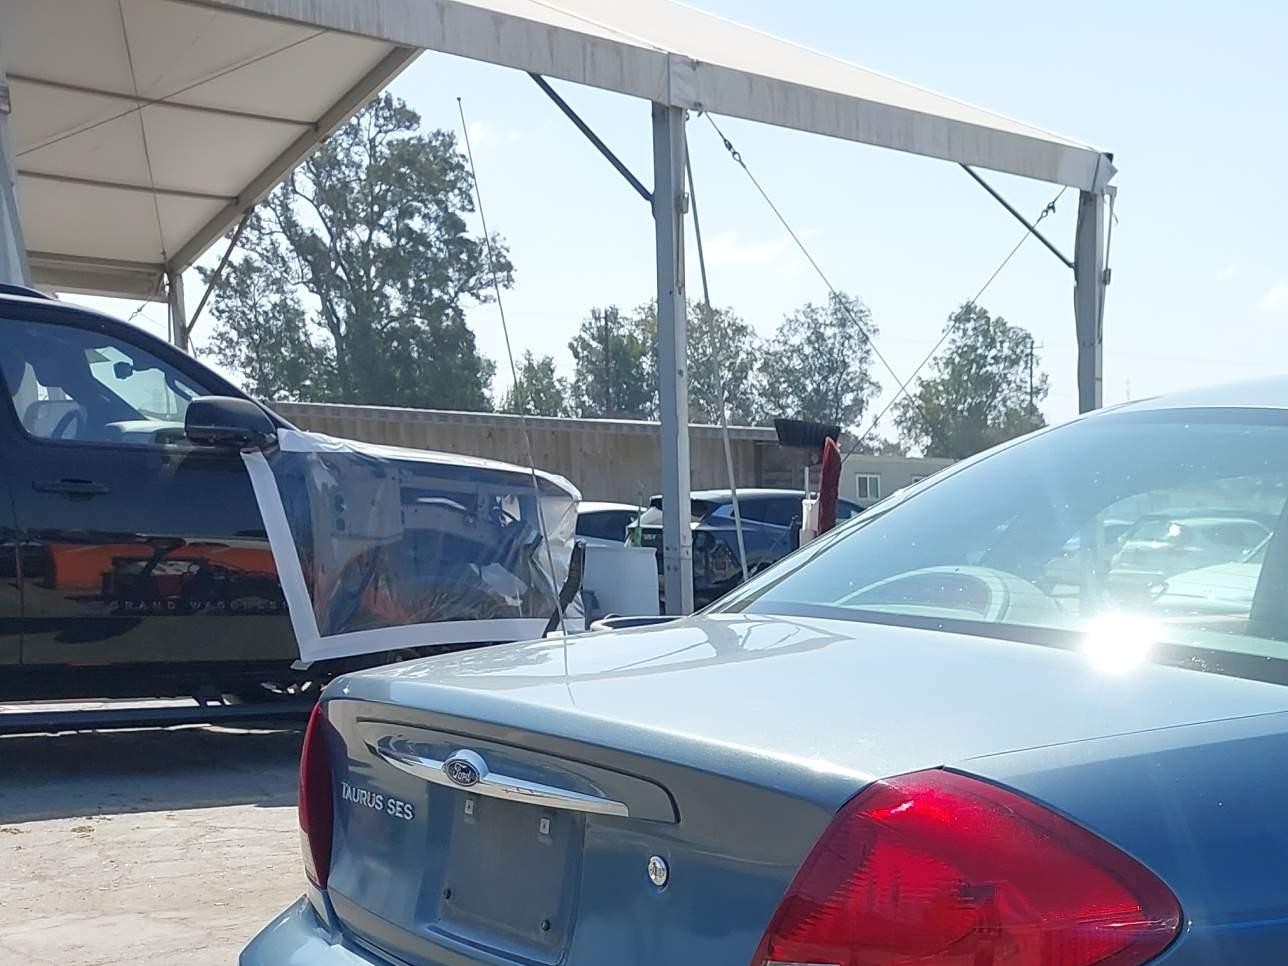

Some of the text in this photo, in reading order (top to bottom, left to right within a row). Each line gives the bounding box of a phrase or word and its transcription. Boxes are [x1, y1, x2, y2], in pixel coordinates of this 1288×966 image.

[110, 599, 177, 611] GRAND
[451, 762, 473, 783] Ford
[341, 781, 414, 821] TAURUS SES
